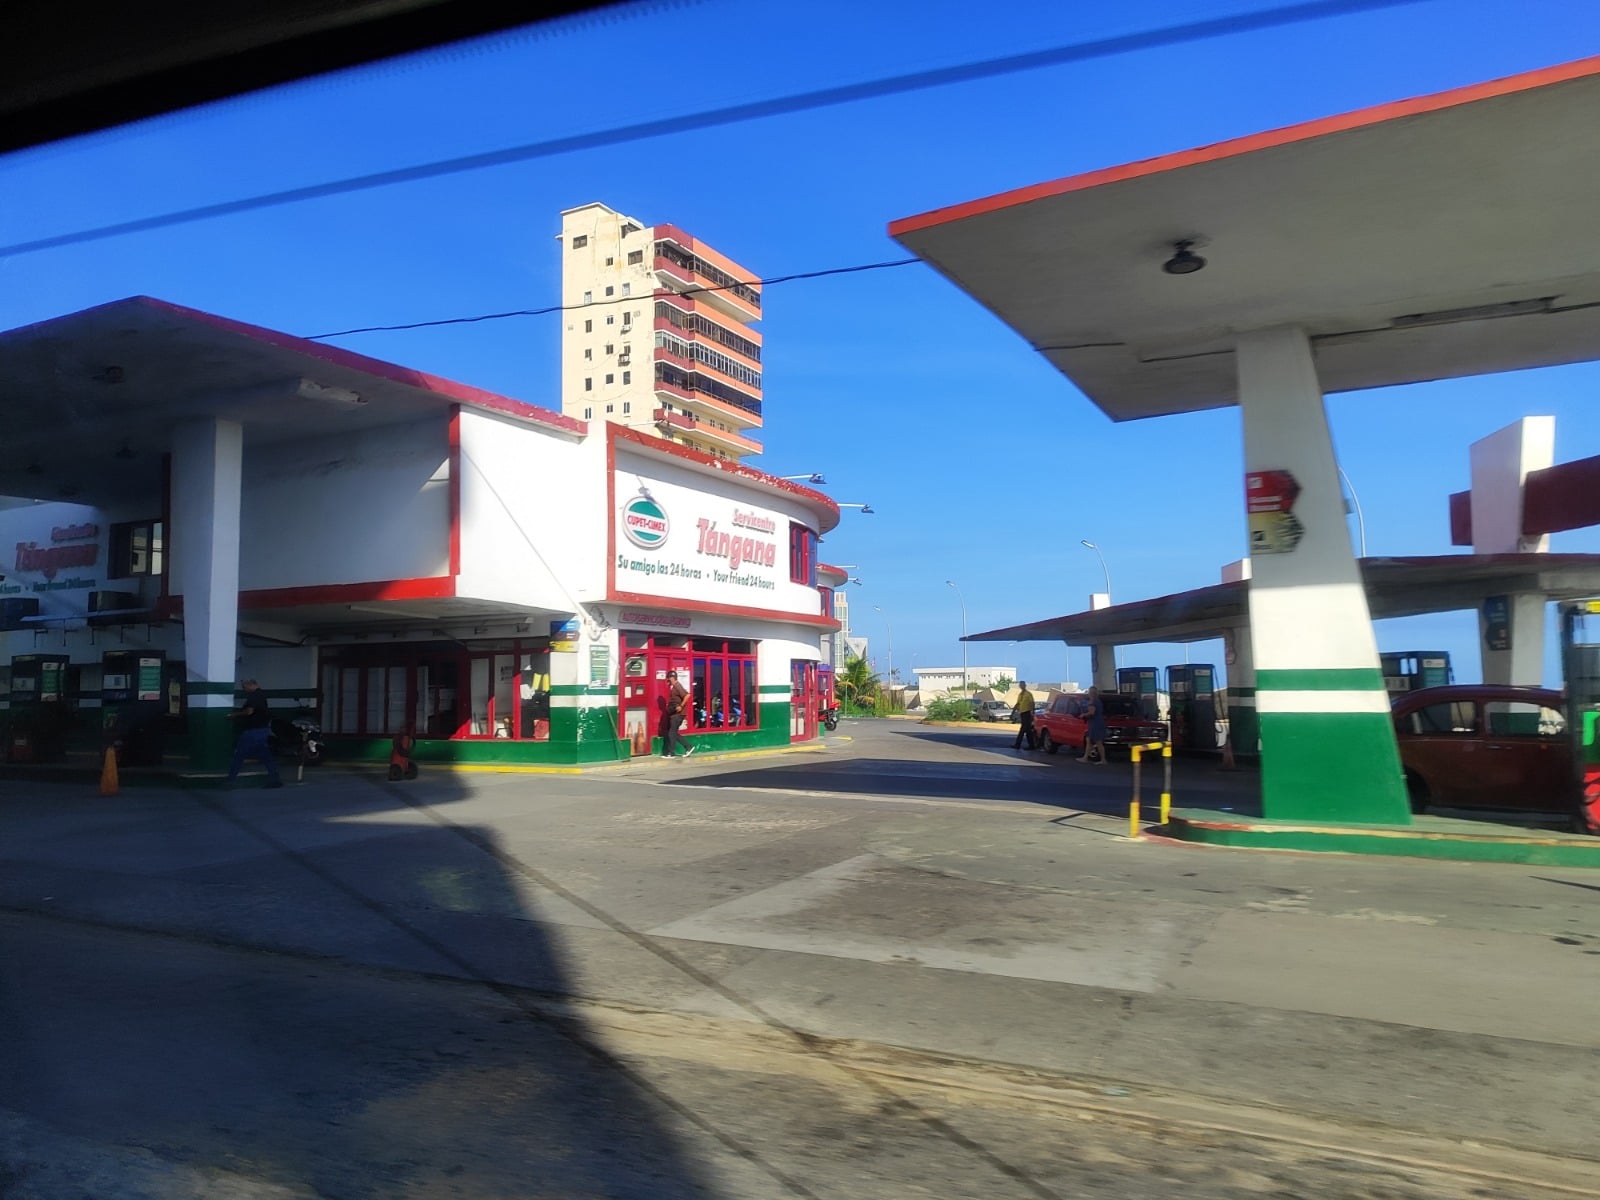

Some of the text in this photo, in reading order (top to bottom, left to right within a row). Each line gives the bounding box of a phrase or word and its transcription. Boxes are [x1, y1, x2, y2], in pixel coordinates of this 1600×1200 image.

[627, 515, 666, 532] CUPET-CIMEX
[733, 508, 775, 532] Servicentro
[697, 517, 776, 568] Tángana
[618, 554, 775, 590] Su amigo las 24 horas Your friend 24 hours
